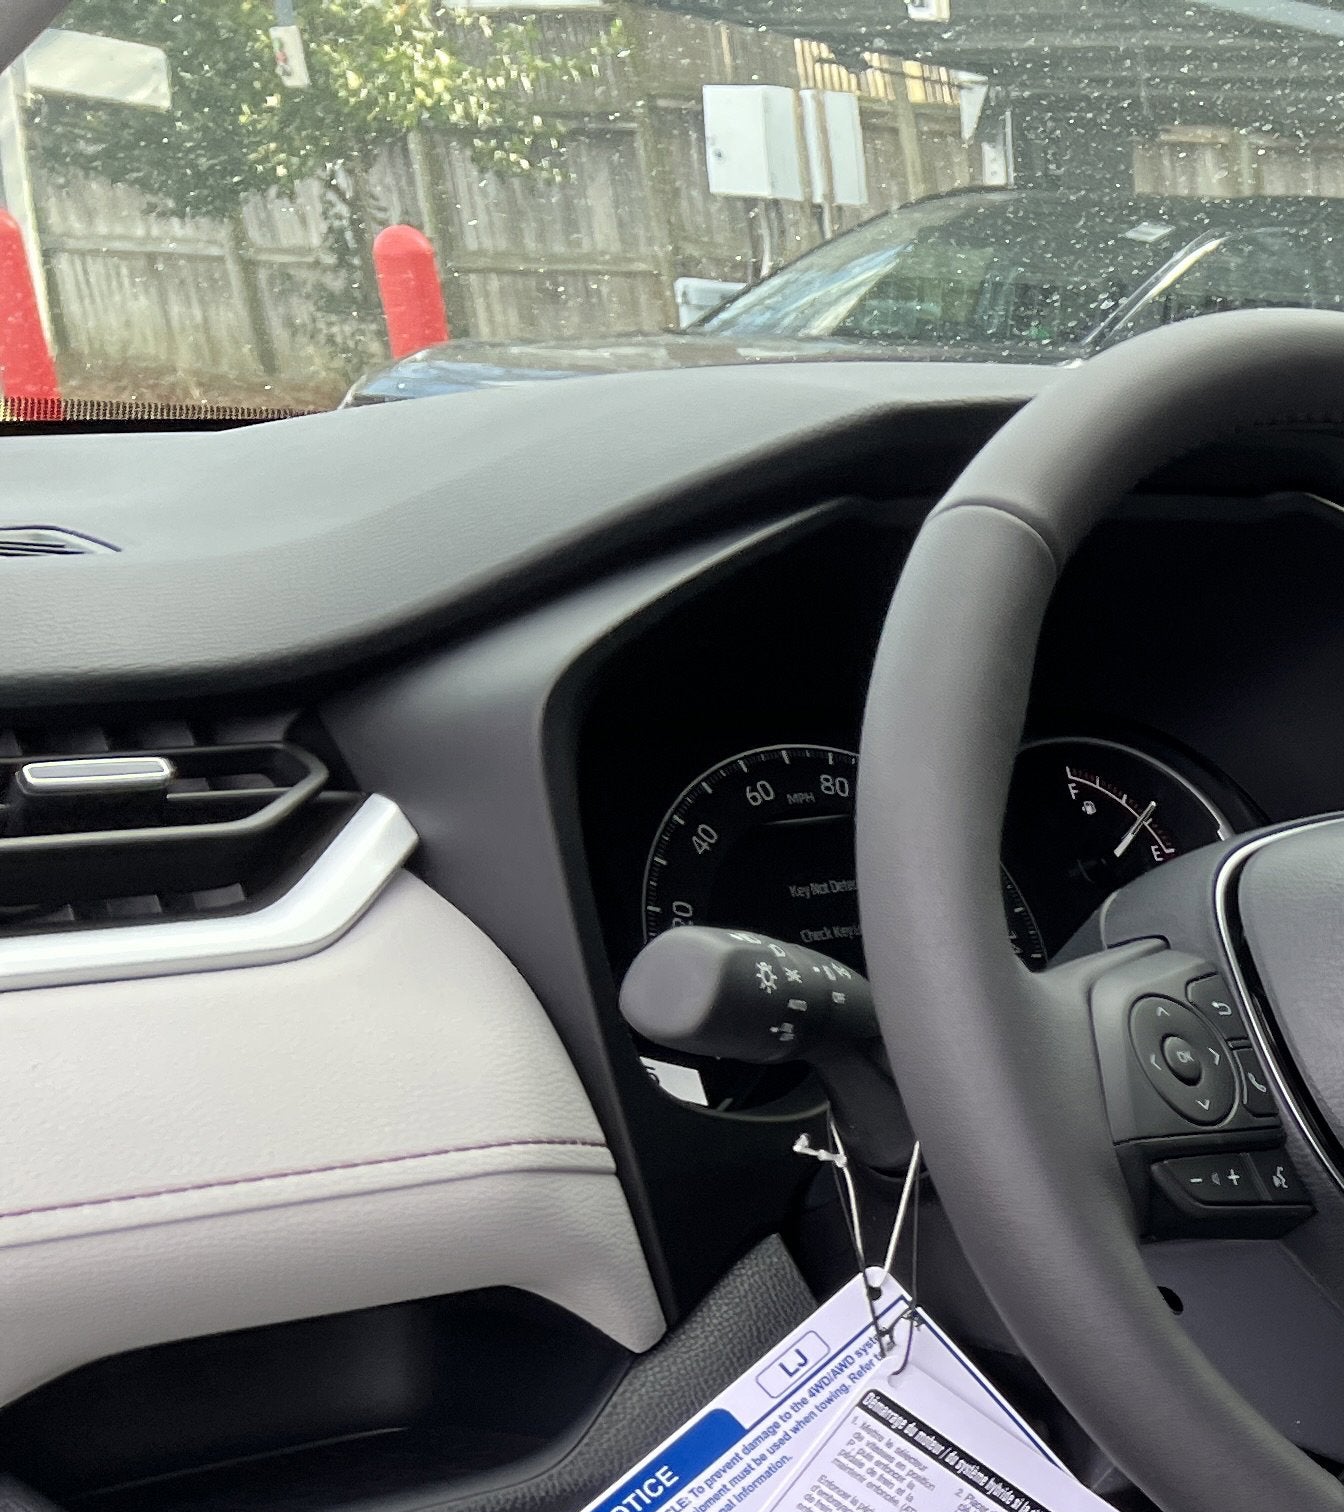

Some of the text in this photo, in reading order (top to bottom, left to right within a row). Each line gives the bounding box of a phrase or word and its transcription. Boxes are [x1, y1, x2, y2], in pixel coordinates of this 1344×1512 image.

[746, 780, 775, 806] 60
[786, 792, 815, 805] MPH
[819, 774, 849, 797] 80
[1068, 783, 1079, 800] F
[692, 823, 718, 854] 40
[1151, 845, 1163, 862] E
[1176, 1050, 1195, 1063] OK
[778, 1348, 808, 1377] LJ
[687, 1485, 705, 1497] To
[703, 1452, 743, 1489] prevent
[741, 1420, 781, 1455] damage
[778, 1411, 792, 1422] to
[789, 1396, 808, 1413] the
[807, 1354, 855, 1398] 4WD/AWD
[728, 1462, 755, 1487] must
[750, 1453, 768, 1466] be
[765, 1430, 792, 1455] used
[788, 1410, 817, 1434] when
[814, 1383, 851, 1412] towing.
[846, 1358, 875, 1384] Refer
[732, 1455, 793, 1503] information.
